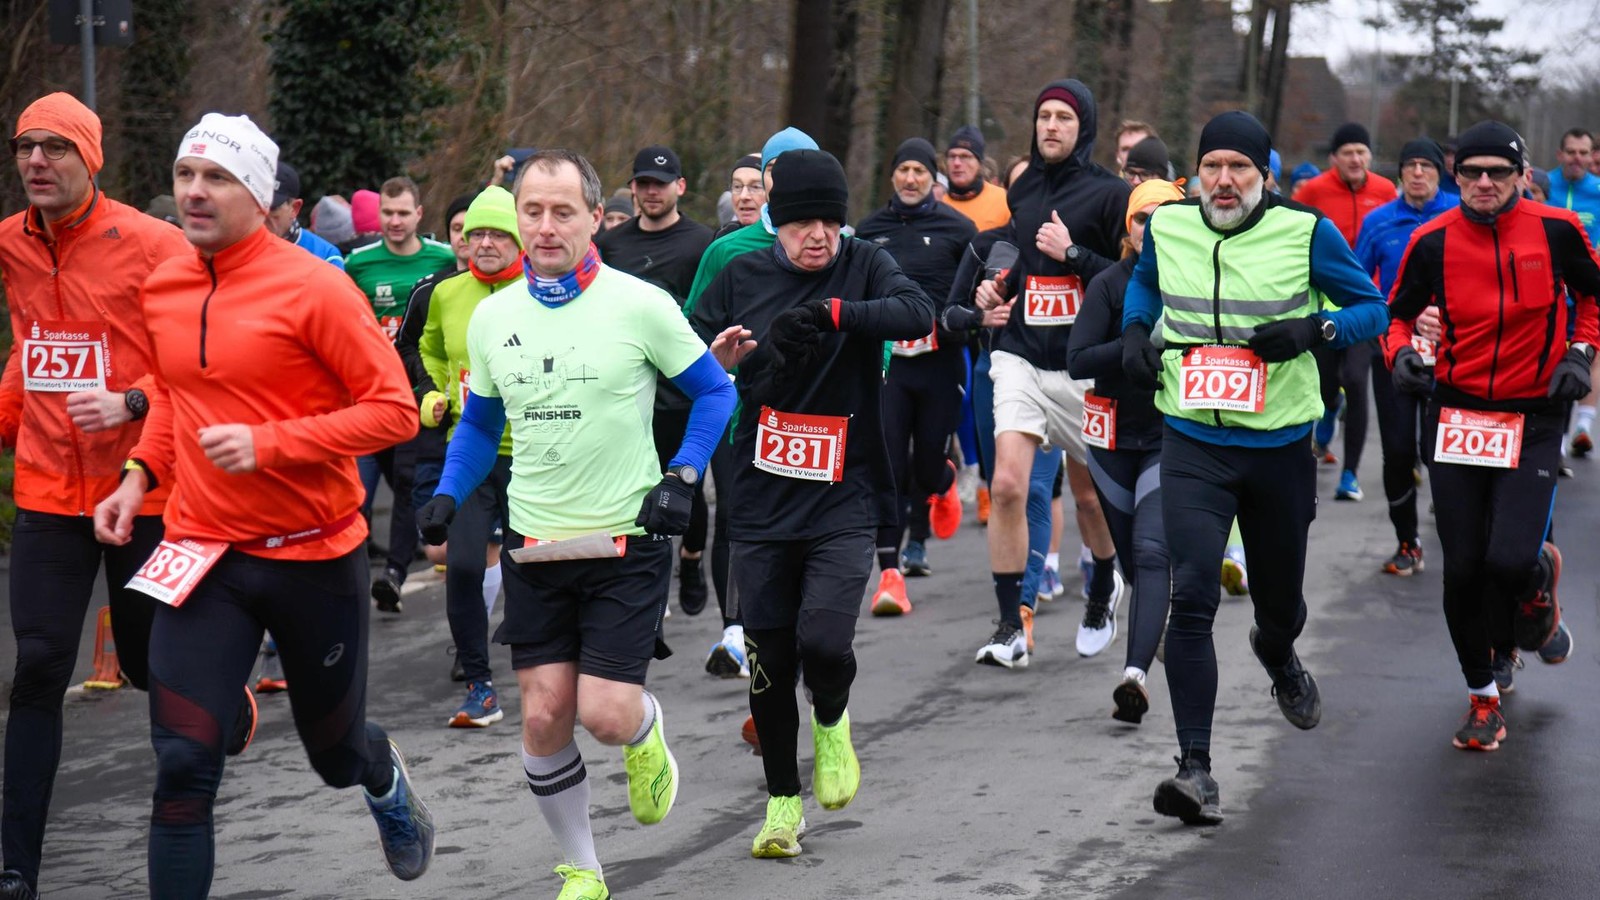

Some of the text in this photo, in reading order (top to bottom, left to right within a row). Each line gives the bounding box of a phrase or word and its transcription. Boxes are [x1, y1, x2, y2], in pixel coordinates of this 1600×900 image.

[1038, 283, 1070, 291] Sparkasse
[1032, 294, 1069, 316] 271
[43, 329, 90, 341] Sparkasse
[31, 346, 90, 378] 257
[1204, 356, 1250, 368] Sparkasse
[1187, 370, 1248, 399] 209
[524, 410, 582, 420] FINISHER
[530, 421, 574, 433] 2024
[782, 421, 828, 434] Sparkasse
[1465, 417, 1507, 429] Sparkasse
[766, 434, 822, 466] 281
[835, 427, 844, 469] www.nispa.de
[1446, 428, 1504, 457] 204
[759, 460, 793, 475] Triminators
[804, 470, 828, 478] Voerde
